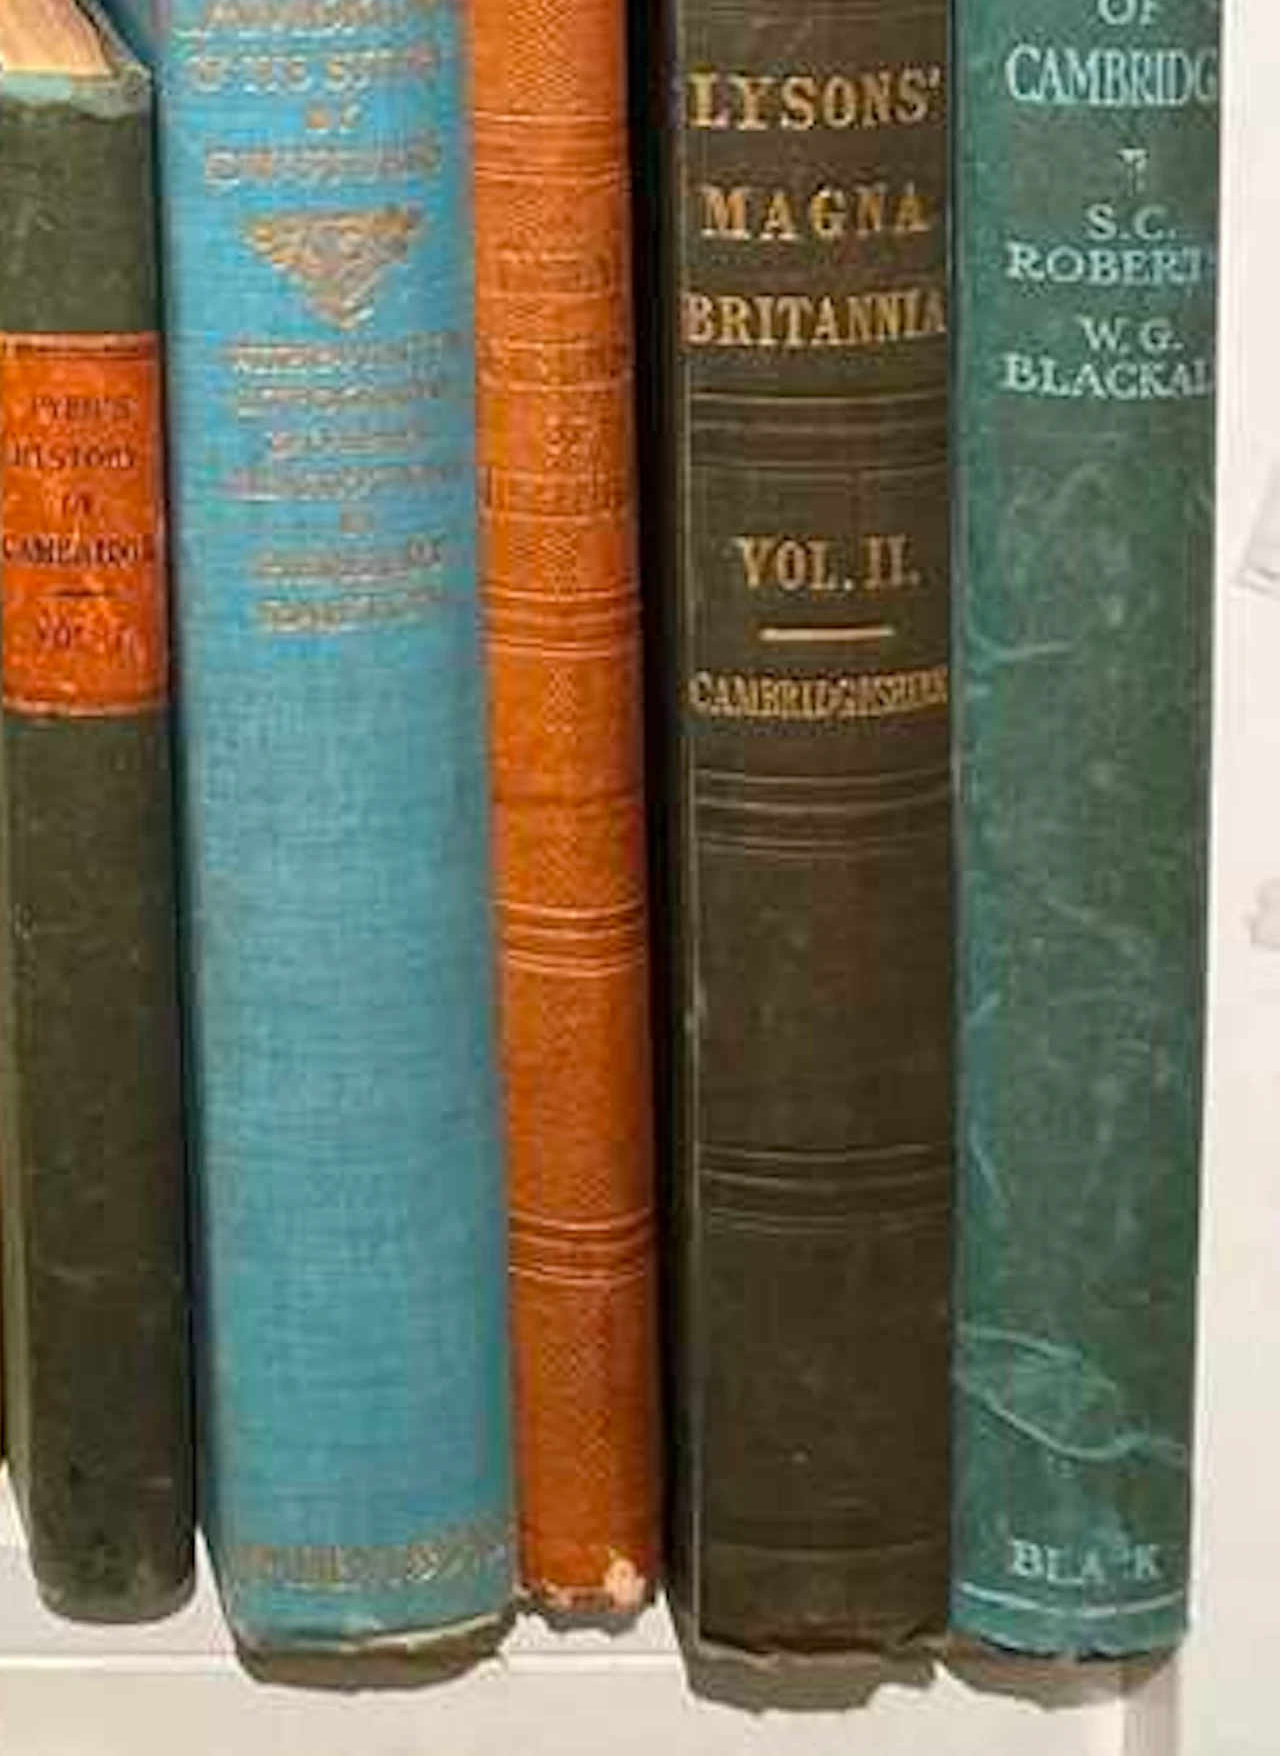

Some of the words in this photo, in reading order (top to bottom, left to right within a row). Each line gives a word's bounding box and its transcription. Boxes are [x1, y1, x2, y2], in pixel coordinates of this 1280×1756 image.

[1005, 43, 1218, 107] CAMBRIDG
[701, 185, 930, 242] MAGNA
[1006, 242, 1215, 286] ROBERT
[683, 289, 947, 346] BRITANNIA
[1000, 353, 1214, 401] BLACKAL
[737, 535, 855, 591] VOL.
